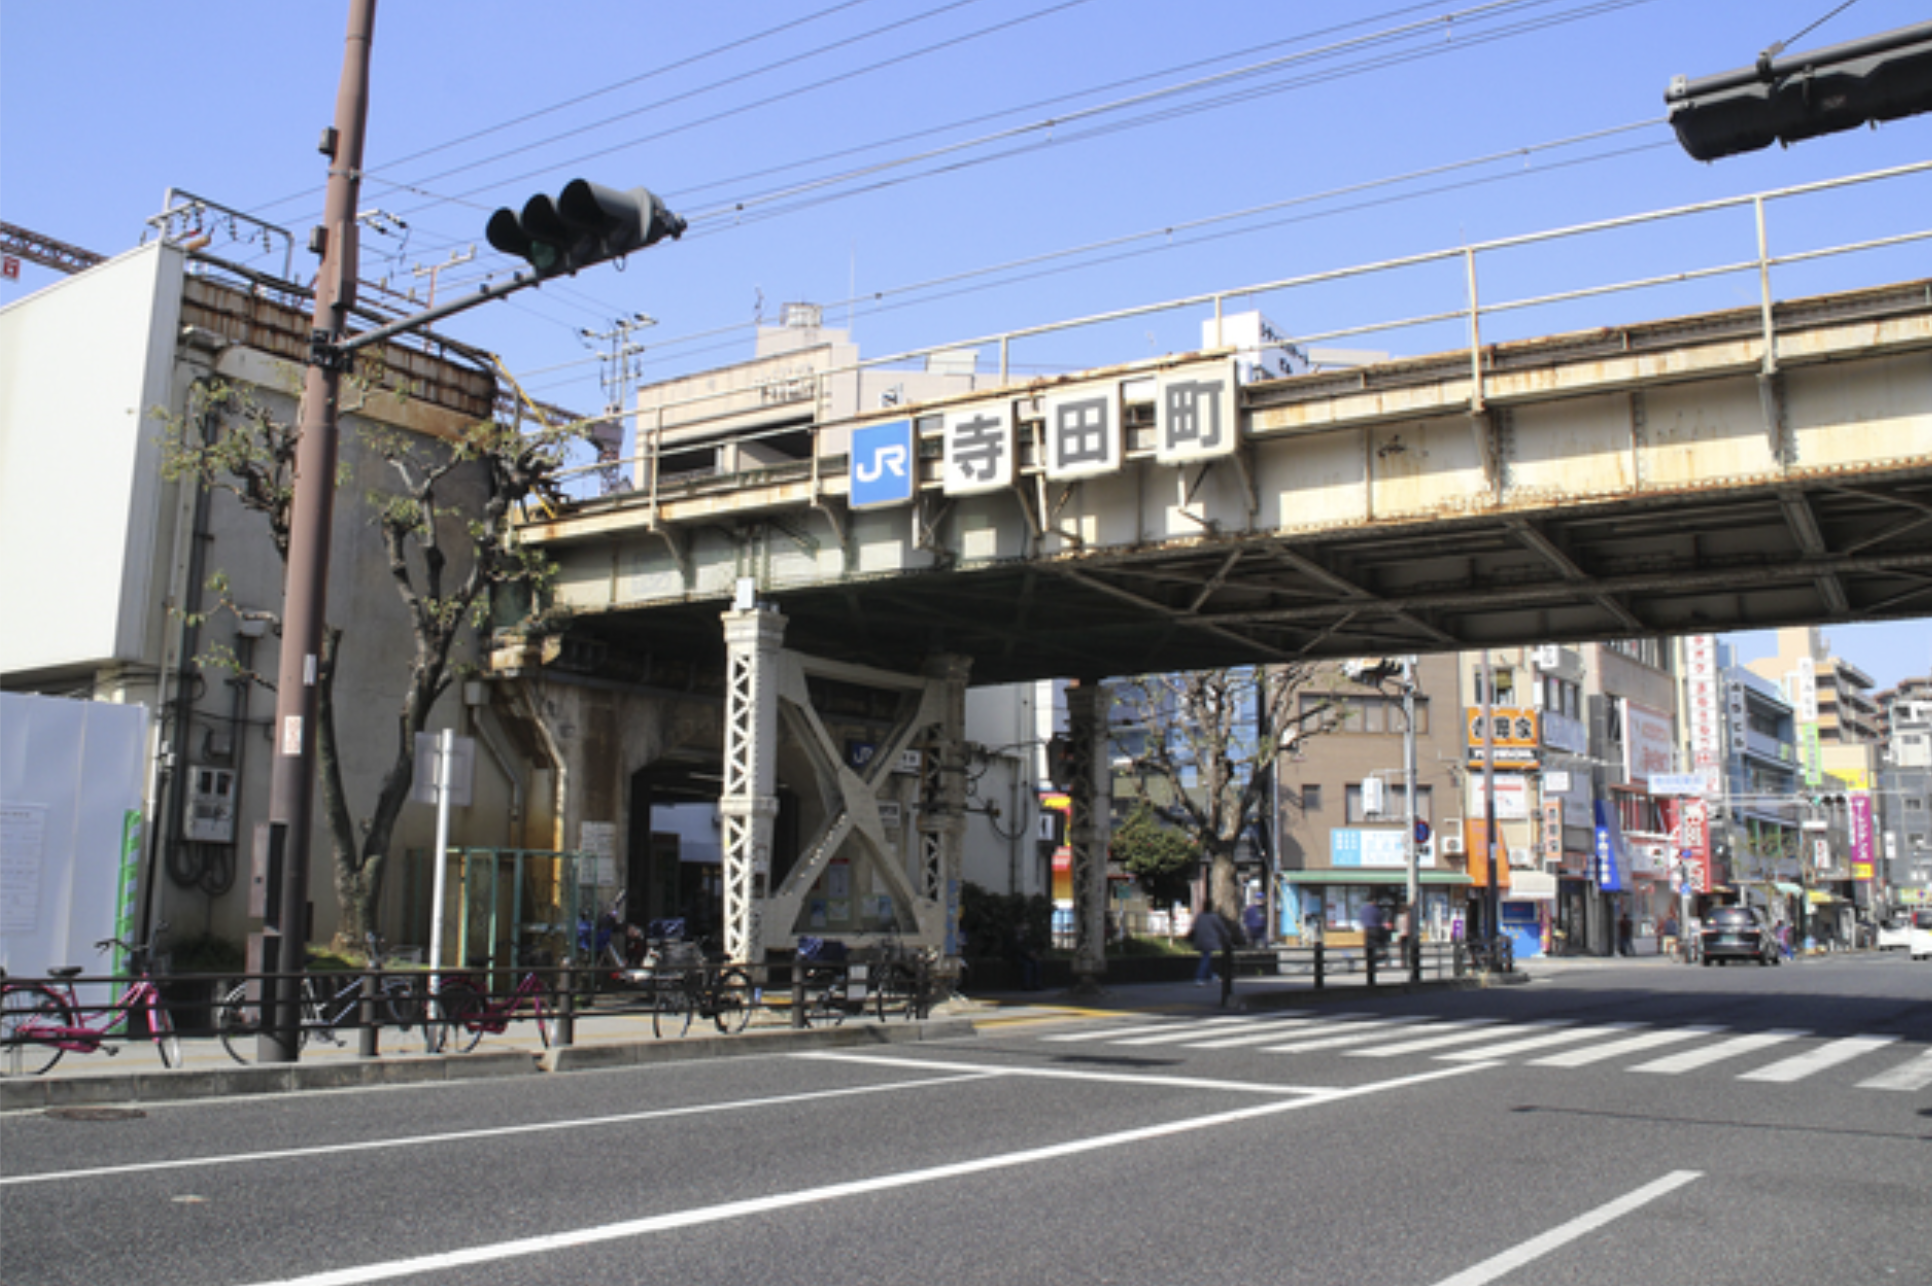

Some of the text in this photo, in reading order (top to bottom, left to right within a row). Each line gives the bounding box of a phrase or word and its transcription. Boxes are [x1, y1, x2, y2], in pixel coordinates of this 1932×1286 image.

[856, 443, 906, 482] JR
[952, 380, 1225, 482] 寺田町
